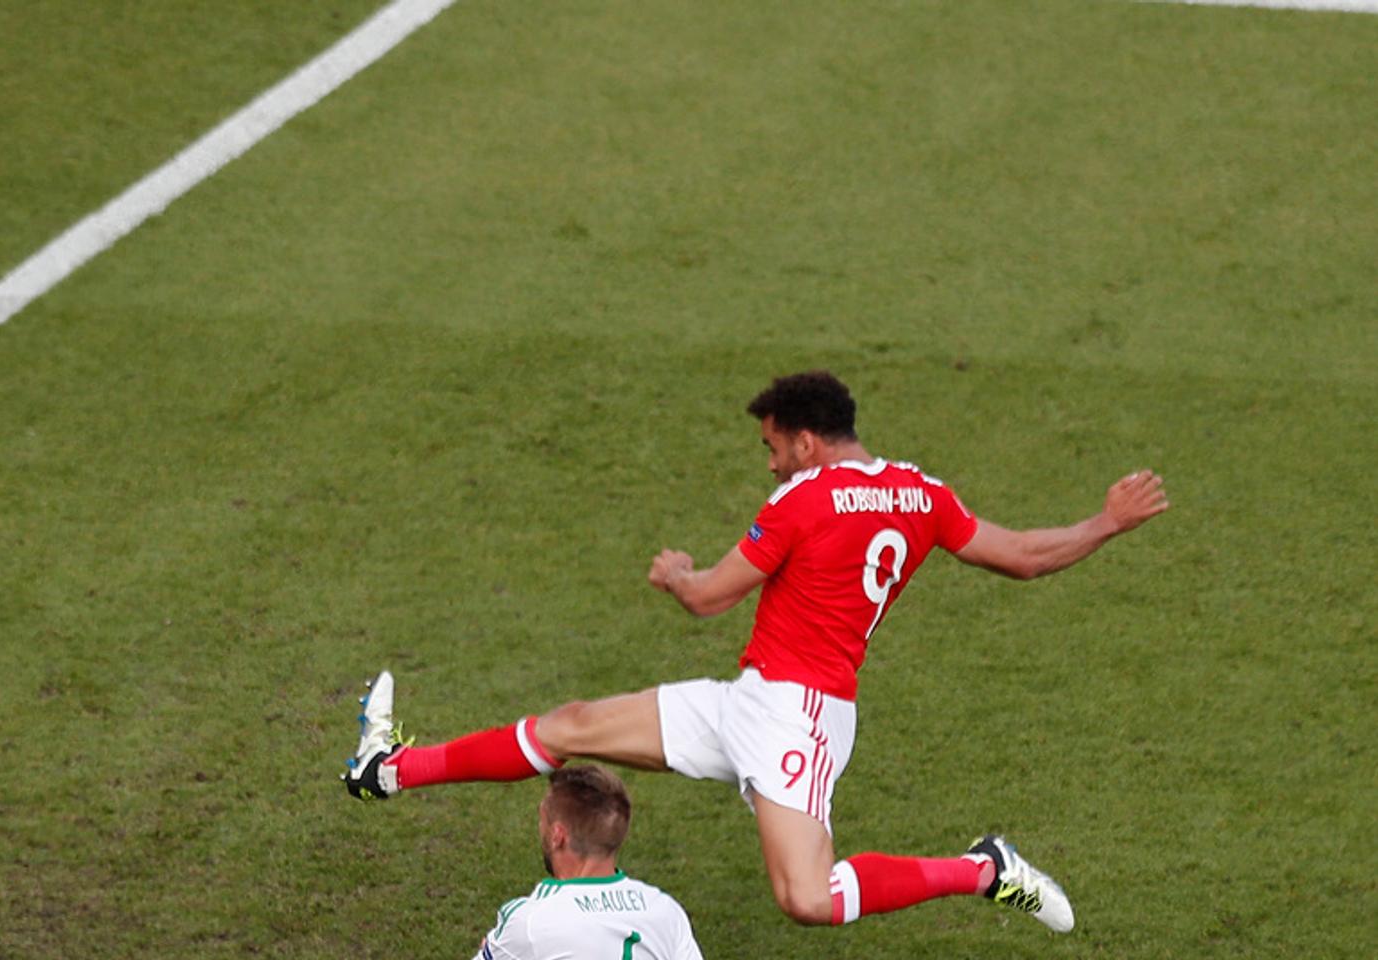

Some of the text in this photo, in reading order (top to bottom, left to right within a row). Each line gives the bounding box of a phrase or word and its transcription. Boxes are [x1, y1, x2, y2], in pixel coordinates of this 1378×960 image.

[862, 528, 908, 640] 9
[781, 750, 807, 789] 9
[574, 889, 648, 912] McAULEY
